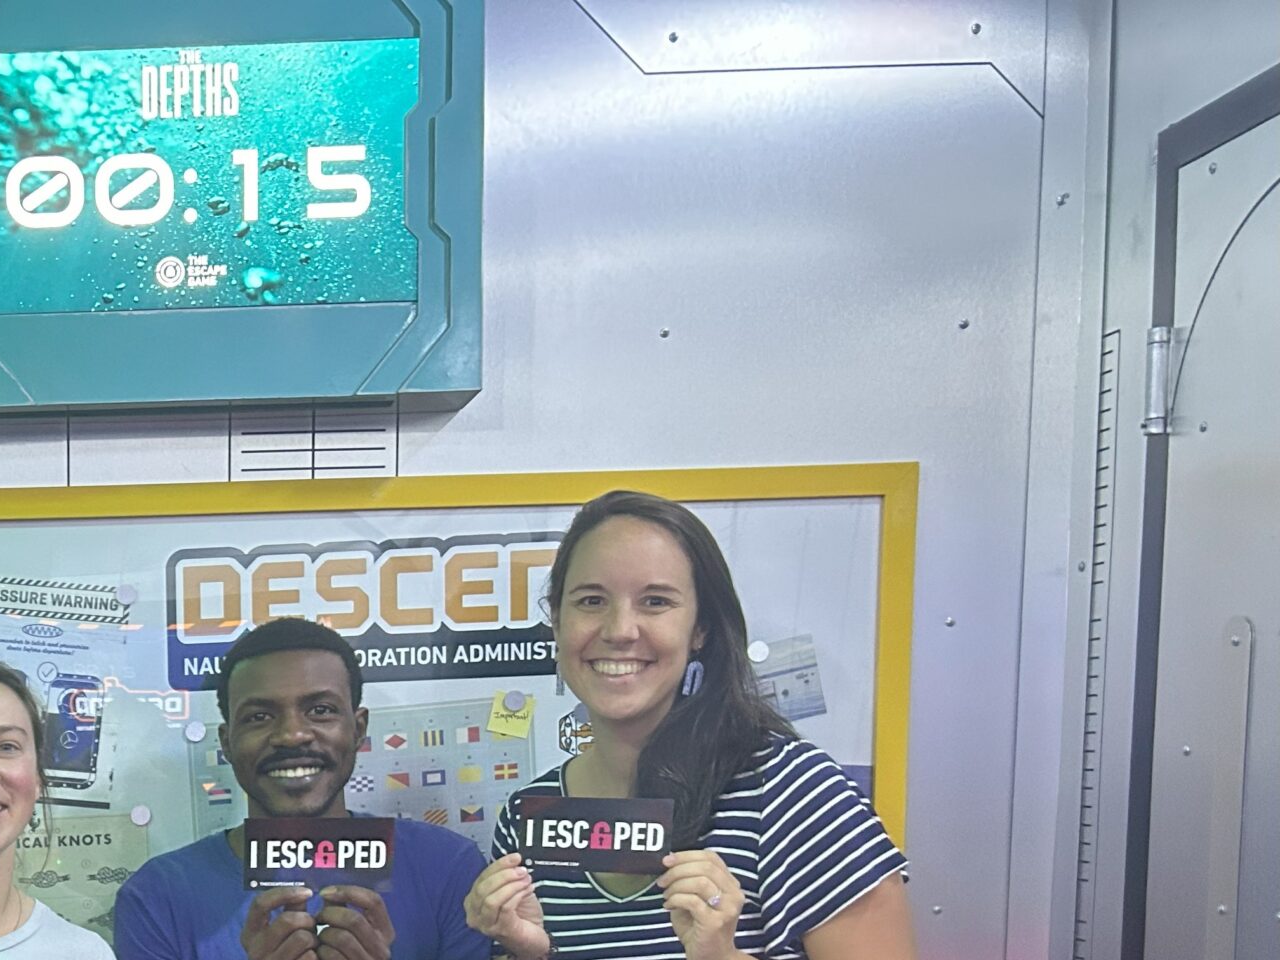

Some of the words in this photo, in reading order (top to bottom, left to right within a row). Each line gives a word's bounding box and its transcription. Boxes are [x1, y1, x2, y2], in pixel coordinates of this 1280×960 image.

[141, 62, 239, 119] DEPTHS
[5, 145, 371, 228] 00:15
[188, 254, 208, 265] THE
[187, 265, 227, 276] ESCAPE
[188, 276, 217, 286] GAME
[51, 593, 120, 611] WARNING
[58, 833, 112, 847] KNOTS
[526, 819, 534, 847] I
[542, 819, 665, 852] ESCAPED
[250, 840, 258, 868] I
[266, 840, 386, 869] ESCAPED
